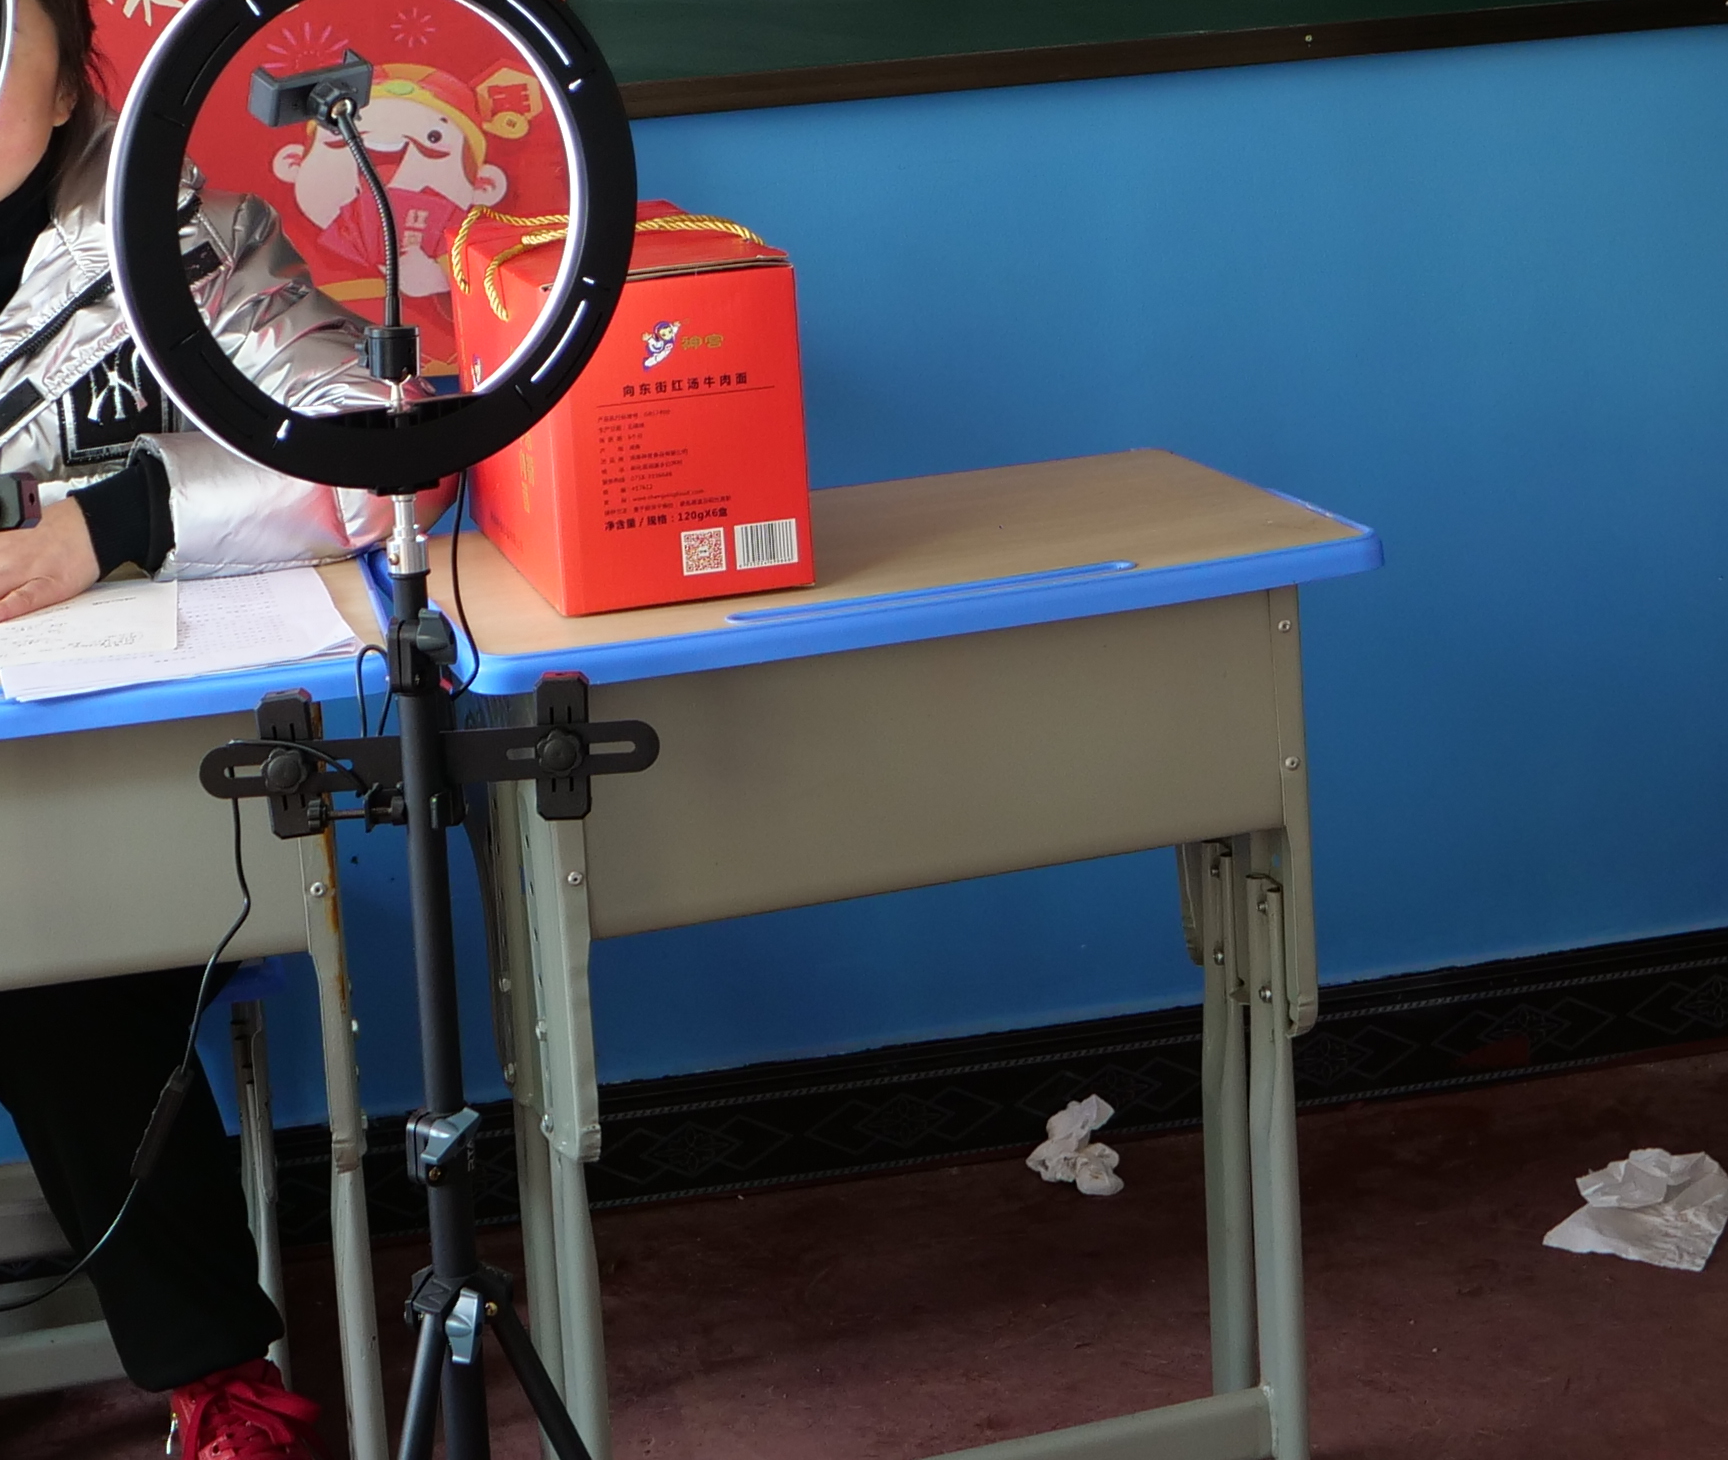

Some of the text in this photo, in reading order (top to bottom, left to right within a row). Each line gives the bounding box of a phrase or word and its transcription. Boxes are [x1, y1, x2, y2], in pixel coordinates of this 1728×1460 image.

[622, 372, 749, 398] 向东街红汤牛肉面
